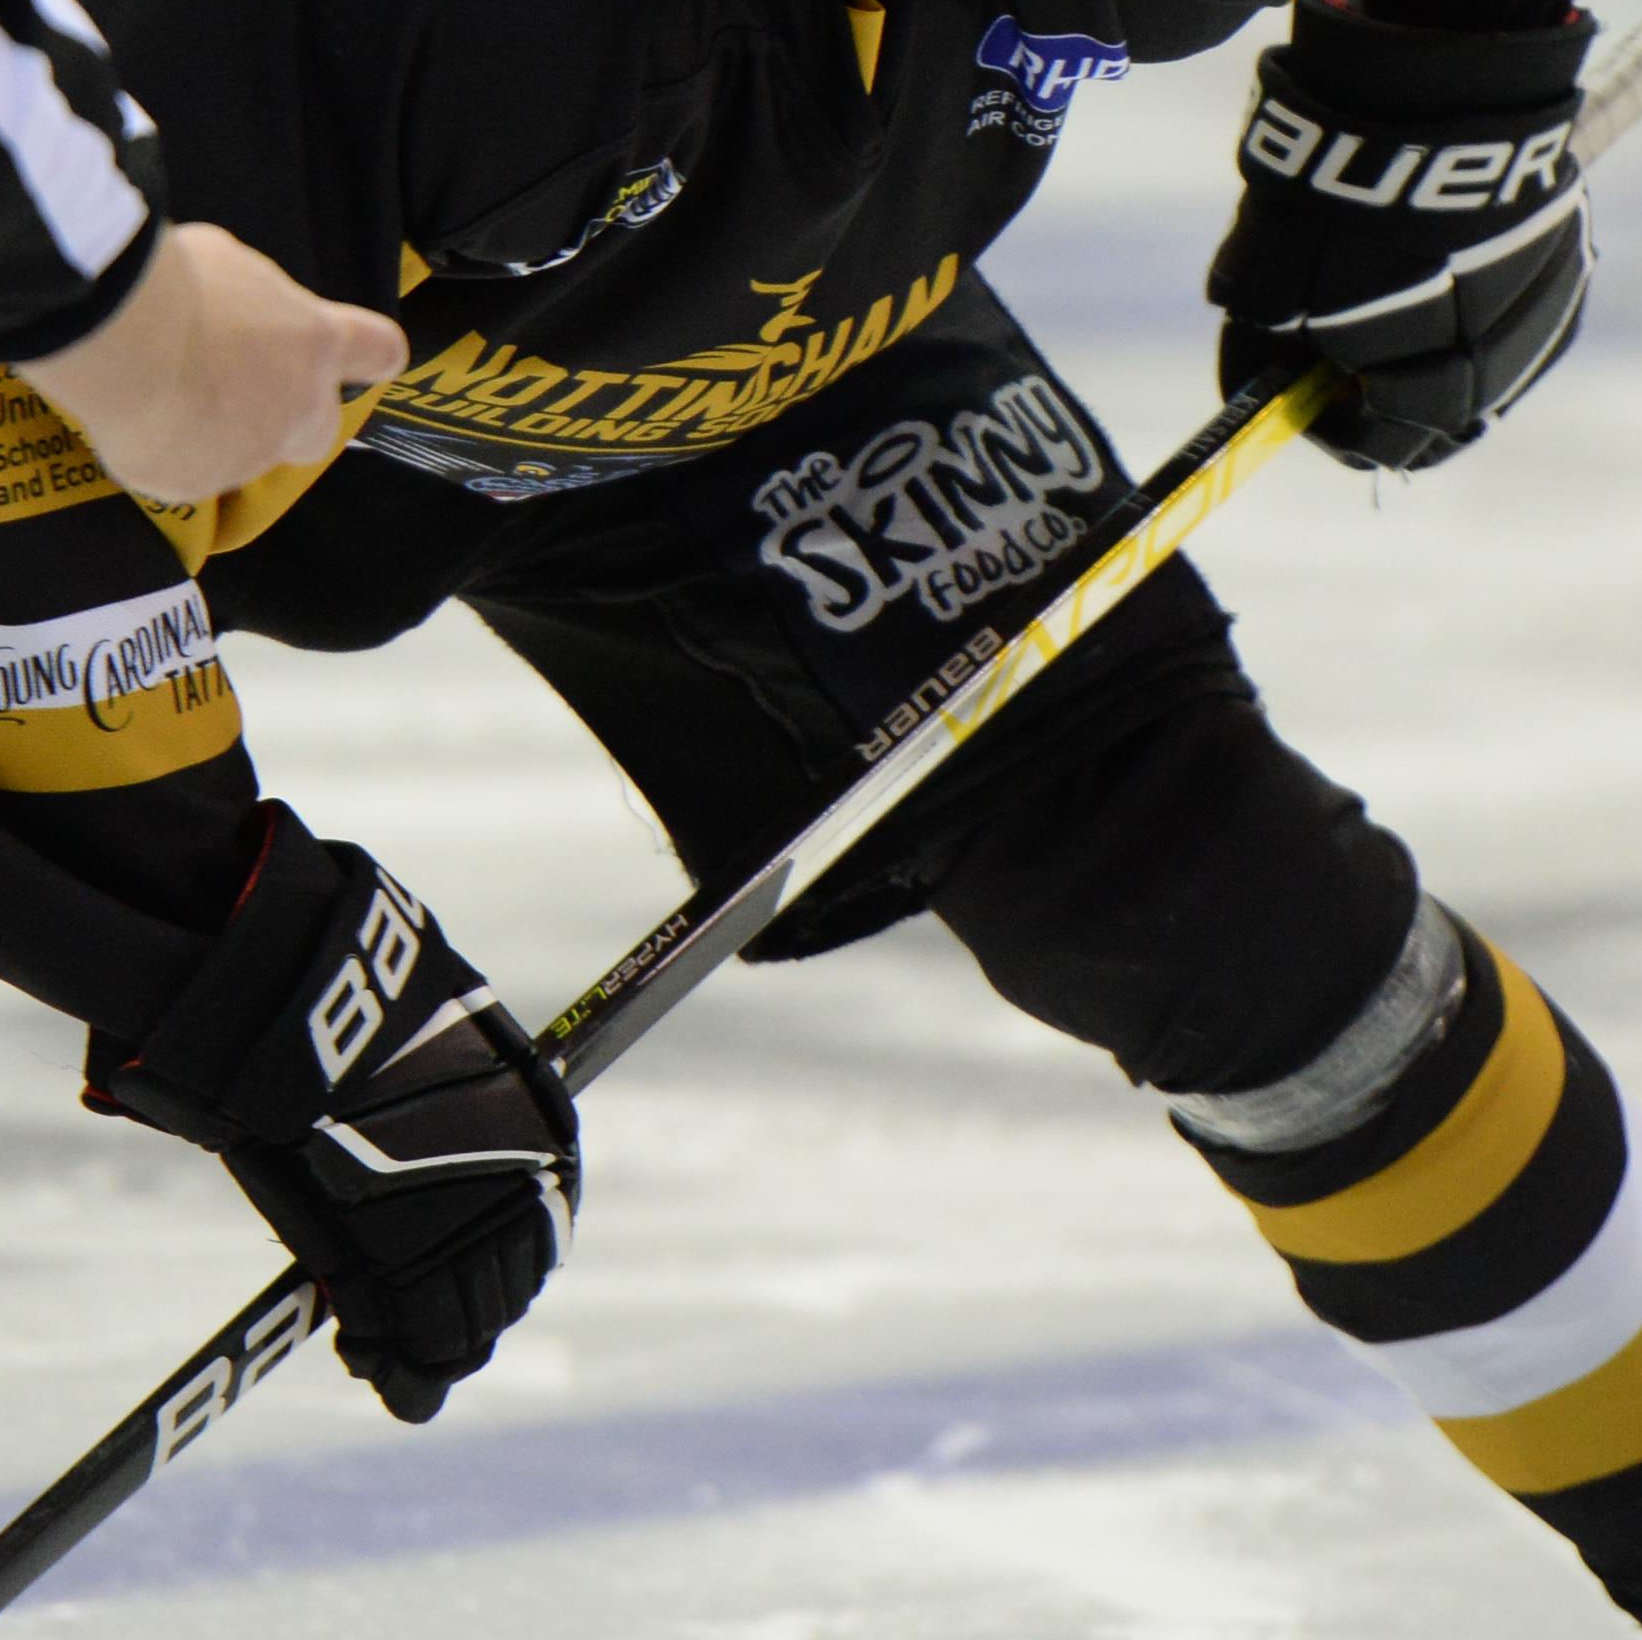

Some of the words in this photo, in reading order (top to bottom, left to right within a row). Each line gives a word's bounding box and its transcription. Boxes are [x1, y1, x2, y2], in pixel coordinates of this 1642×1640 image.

[966, 110, 1006, 137] AIR
[1246, 98, 1573, 211] AUER
[378, 385, 676, 442] BUILDING
[779, 383, 1093, 619] SKINNY
[165, 654, 233, 715] TATT
[854, 625, 1004, 762] BAUER
[155, 1279, 318, 1465] BA
